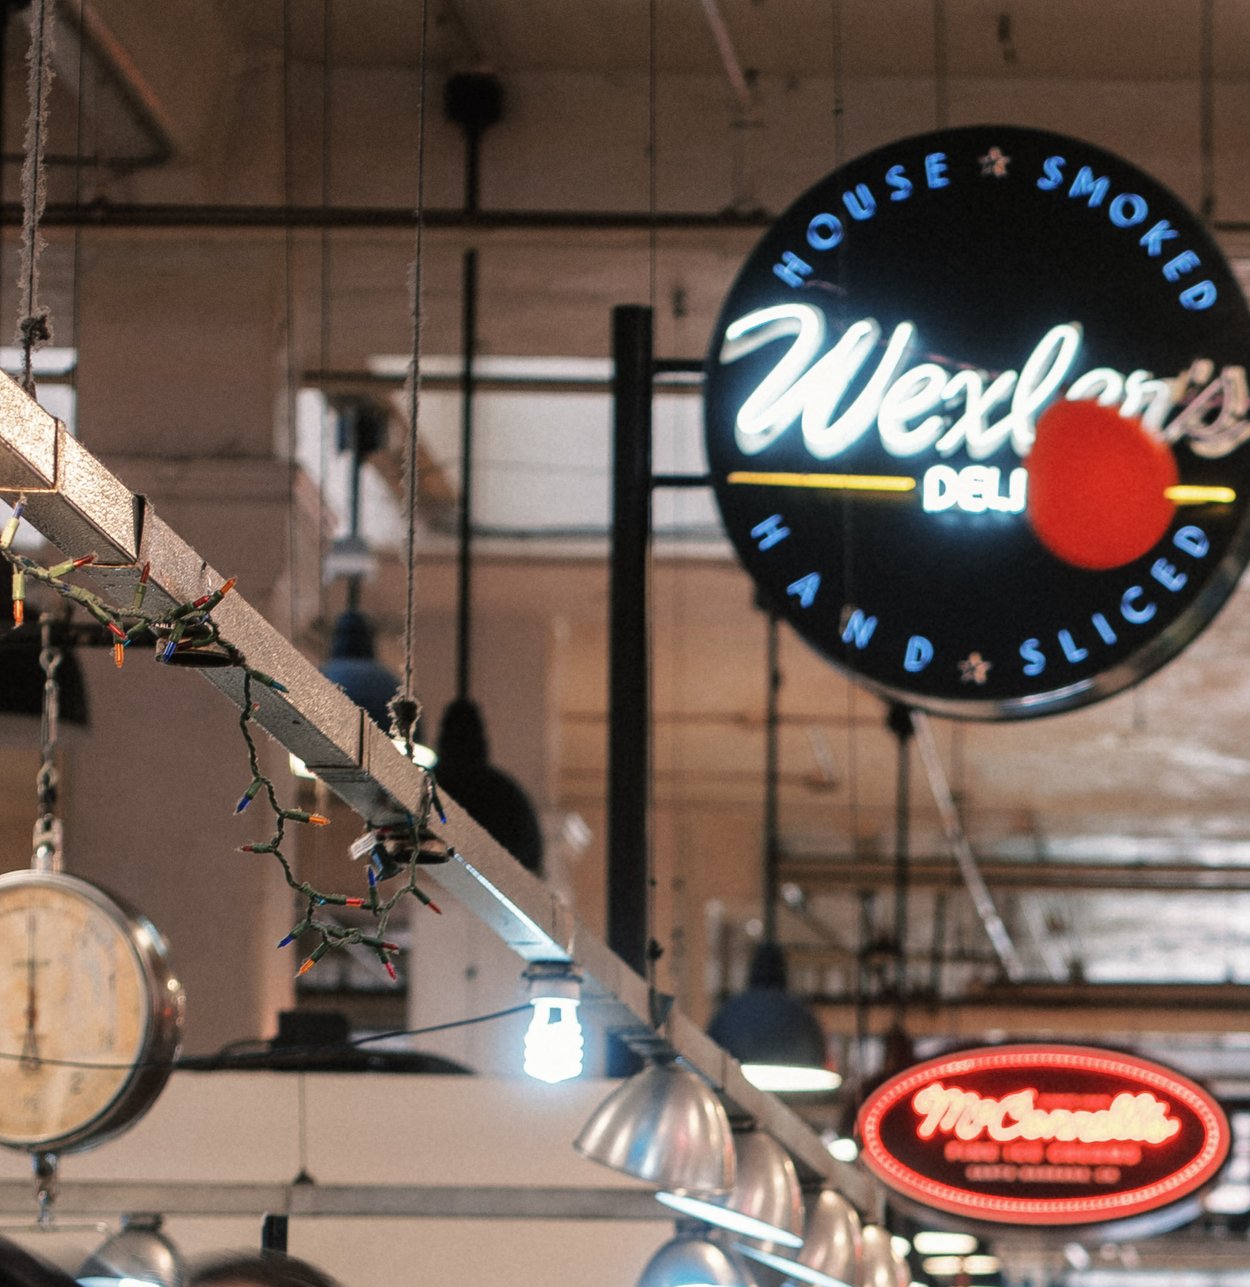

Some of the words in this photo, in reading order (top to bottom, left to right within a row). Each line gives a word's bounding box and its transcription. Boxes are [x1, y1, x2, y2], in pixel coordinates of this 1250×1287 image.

[773, 152, 952, 288] HOUSE
[1037, 155, 1218, 310] SMOKED
[922, 465, 1028, 513] DELI
[750, 513, 934, 672] HAND
[1019, 524, 1210, 677] SLICED
